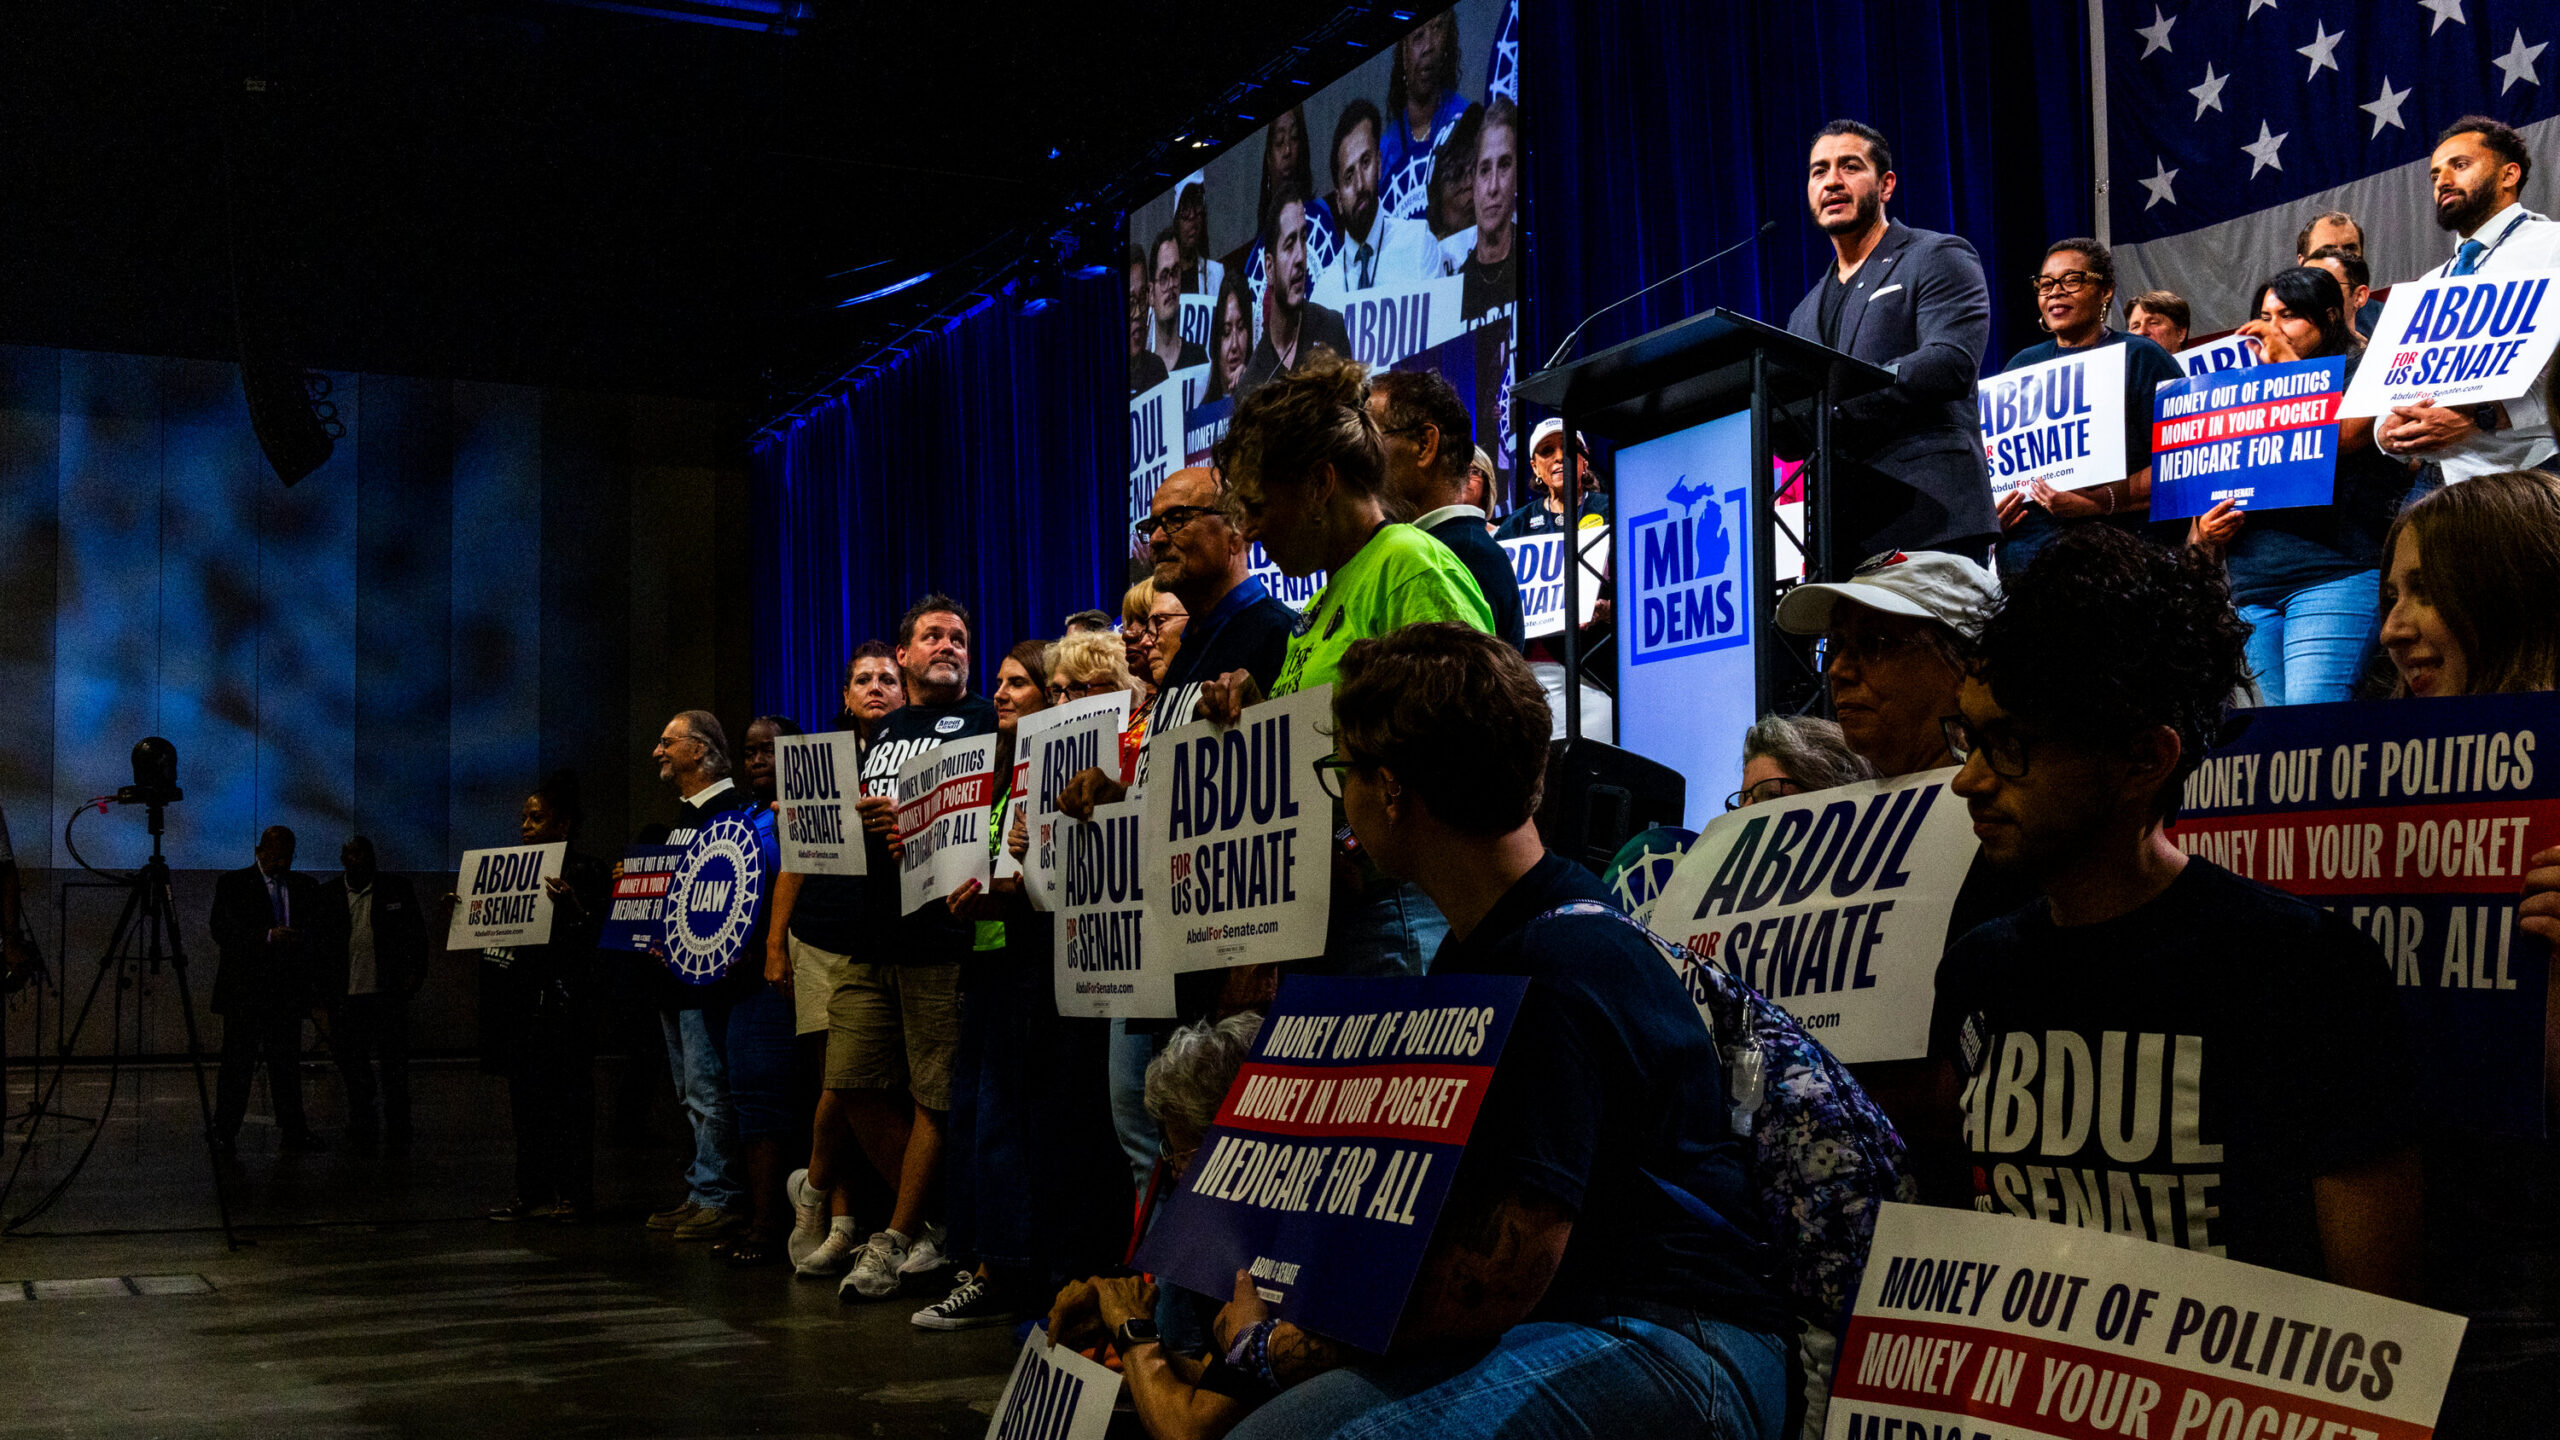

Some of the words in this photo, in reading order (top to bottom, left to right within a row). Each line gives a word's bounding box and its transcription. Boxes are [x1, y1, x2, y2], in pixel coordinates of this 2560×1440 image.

[2399, 278, 2550, 345] ABDUL
[2384, 365, 2412, 386] US
[2412, 338, 2528, 386] SENATE
[2392, 351, 2418, 368] FOR
[1978, 361, 2092, 439] ABDUL
[2162, 388, 2208, 419] MONEY
[2211, 385, 2239, 408] OUT
[2241, 381, 2260, 403] OF
[2263, 369, 2331, 400] POLITICS
[2390, 384, 2483, 401] AbdulForSenate.com
[1187, 422, 1215, 454] MONEY
[1997, 418, 2091, 477] SENATE
[2161, 418, 2206, 446] MONEY
[2208, 415, 2224, 437] IN
[2228, 408, 2265, 433] YOUR
[2269, 398, 2329, 427] POCKET
[2159, 440, 2242, 483] MEDICARE
[2247, 434, 2284, 468] FOR
[2289, 429, 2324, 462] ALL
[1644, 516, 1694, 591] MI
[1644, 580, 1735, 648] DEMS
[783, 743, 840, 800] ABDUL
[920, 766, 934, 793] OUT
[941, 748, 985, 782] POLITICS
[1169, 713, 1299, 842] ABDUL
[2269, 747, 2323, 805] OUT
[2331, 743, 2369, 800] OF
[2378, 729, 2537, 797] POLITICS
[942, 779, 983, 813] POCKET
[789, 822, 799, 841] US
[797, 805, 845, 844] SENATE
[952, 812, 977, 846] ALL
[1041, 823, 1051, 845] FOR
[2267, 827, 2295, 880] IN
[2305, 823, 2384, 880] YOUR
[2394, 816, 2531, 879] POCKET
[472, 850, 544, 895] ABDUL
[1040, 842, 1050, 869] US
[1066, 815, 1143, 907] ABDUL
[1171, 853, 1191, 884] FOR
[1171, 877, 1191, 916] US
[1195, 827, 1297, 916] SENATE
[1693, 783, 1944, 920] ABDUL
[469, 911, 481, 925] US
[482, 894, 537, 926] SENATE
[470, 900, 483, 912] FOR
[610, 899, 652, 921] MEDICARE
[690, 880, 733, 912] UAW
[1066, 918, 1077, 942] FOR
[1067, 939, 1077, 969] US
[1186, 919, 1278, 945] AbdulForSenate.com
[1725, 900, 1896, 1000] SENATE
[2352, 905, 2425, 987] OR
[2440, 905, 2517, 990] ALL
[1076, 982, 1133, 994] AbdulForSenate.com
[1261, 1015, 1340, 1060] MONEY
[1333, 1013, 1378, 1060] OUT
[1368, 1011, 1403, 1058] OF
[1391, 1006, 1495, 1057] POLITICS
[1233, 1074, 1315, 1123] MONEY
[1304, 1079, 1337, 1124] IN
[1329, 1076, 1383, 1125] YOUR
[1374, 1076, 1469, 1129] POCKET
[1959, 1029, 2224, 1165] ABDUL
[1191, 1135, 1332, 1212] MEDICARE
[1315, 1146, 1377, 1216] FOR
[1365, 1149, 1433, 1226] ALL
[1992, 1162, 2227, 1259] SENATE
[1878, 1257, 2000, 1316] MONEY
[2002, 1268, 2089, 1332] OUT
[2095, 1283, 2159, 1345] OF
[2165, 1297, 2402, 1401] POLITICS
[1857, 1331, 1973, 1396] MONEY
[1971, 1346, 2027, 1408] IN
[2036, 1357, 2162, 1439] YOUR
[2170, 1388, 2379, 1440] POCK
